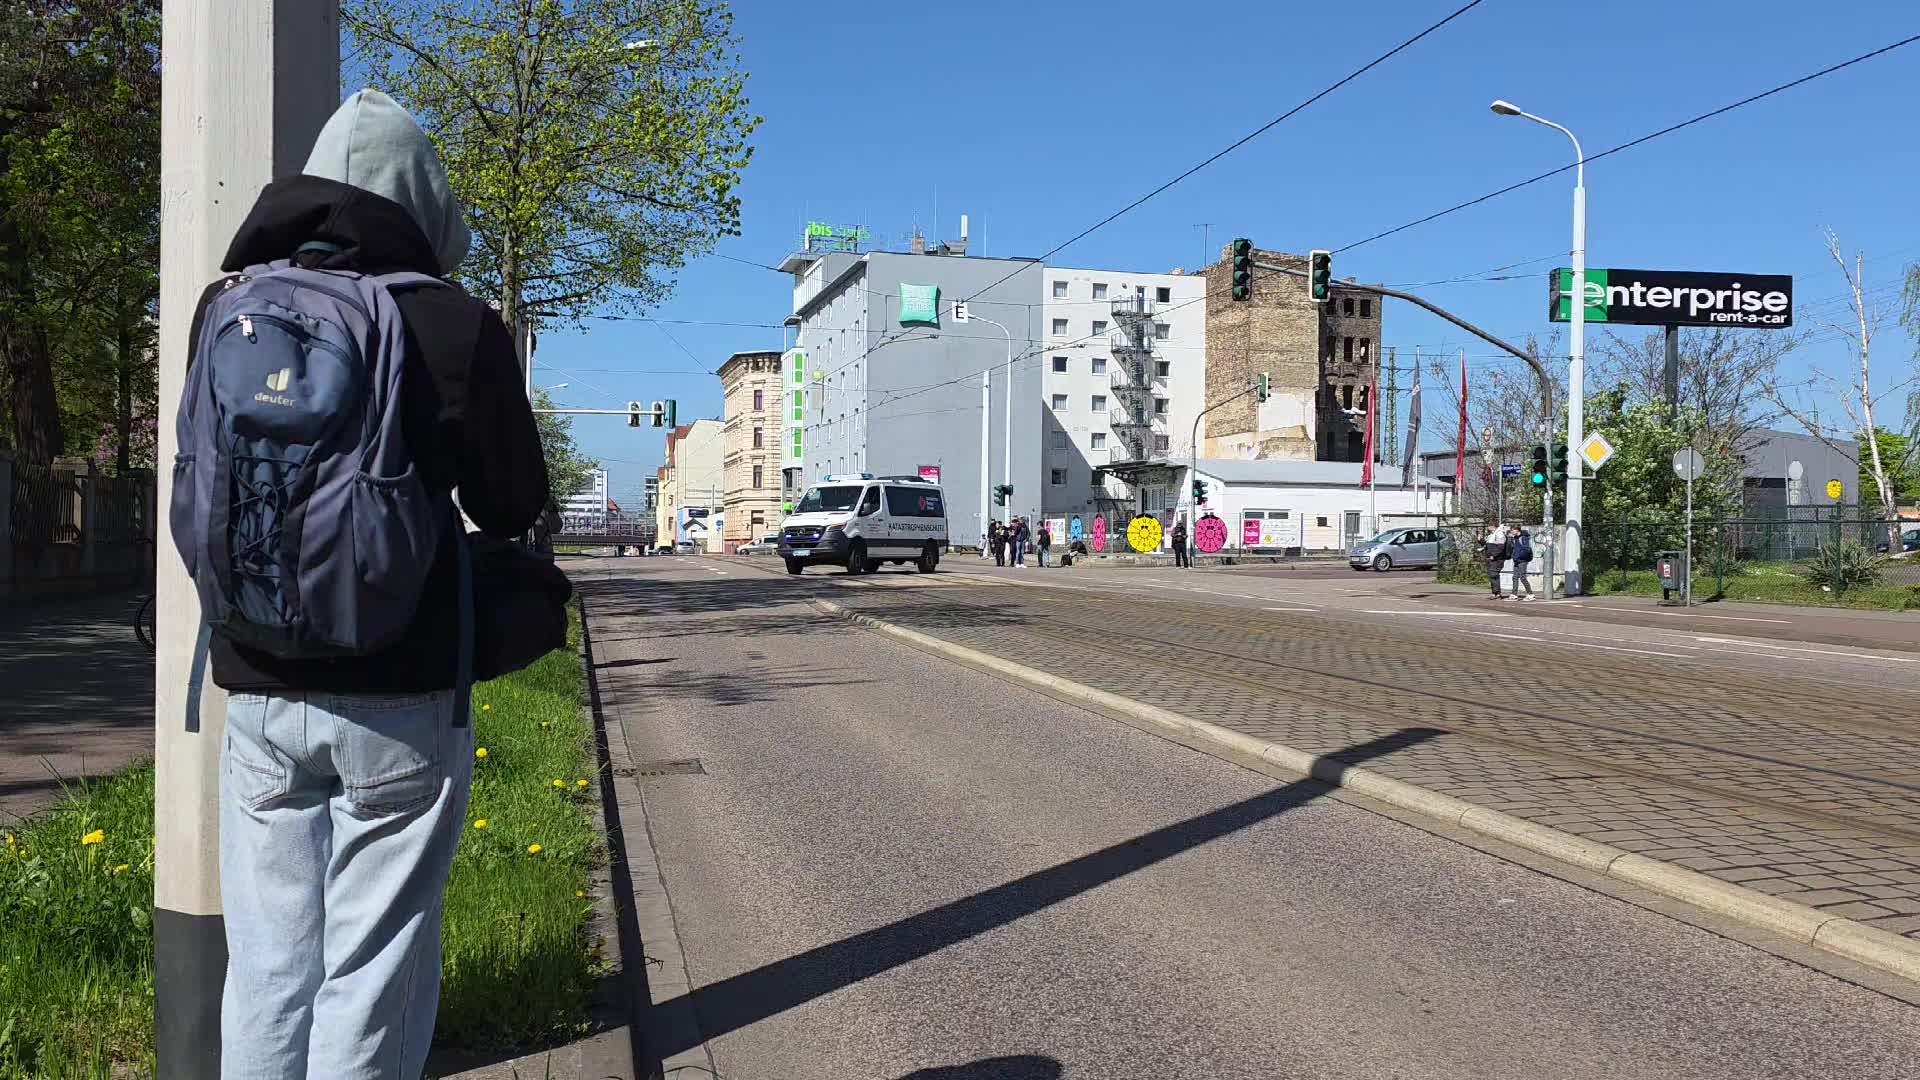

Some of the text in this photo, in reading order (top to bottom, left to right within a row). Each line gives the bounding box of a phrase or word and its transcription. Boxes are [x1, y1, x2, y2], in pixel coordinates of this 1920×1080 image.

[808, 221, 832, 237] ibis
[1561, 281, 1788, 316] enterprise
[955, 305, 964, 319] E
[1710, 311, 1788, 324] rent-a-car
[254, 392, 296, 407] deuter
